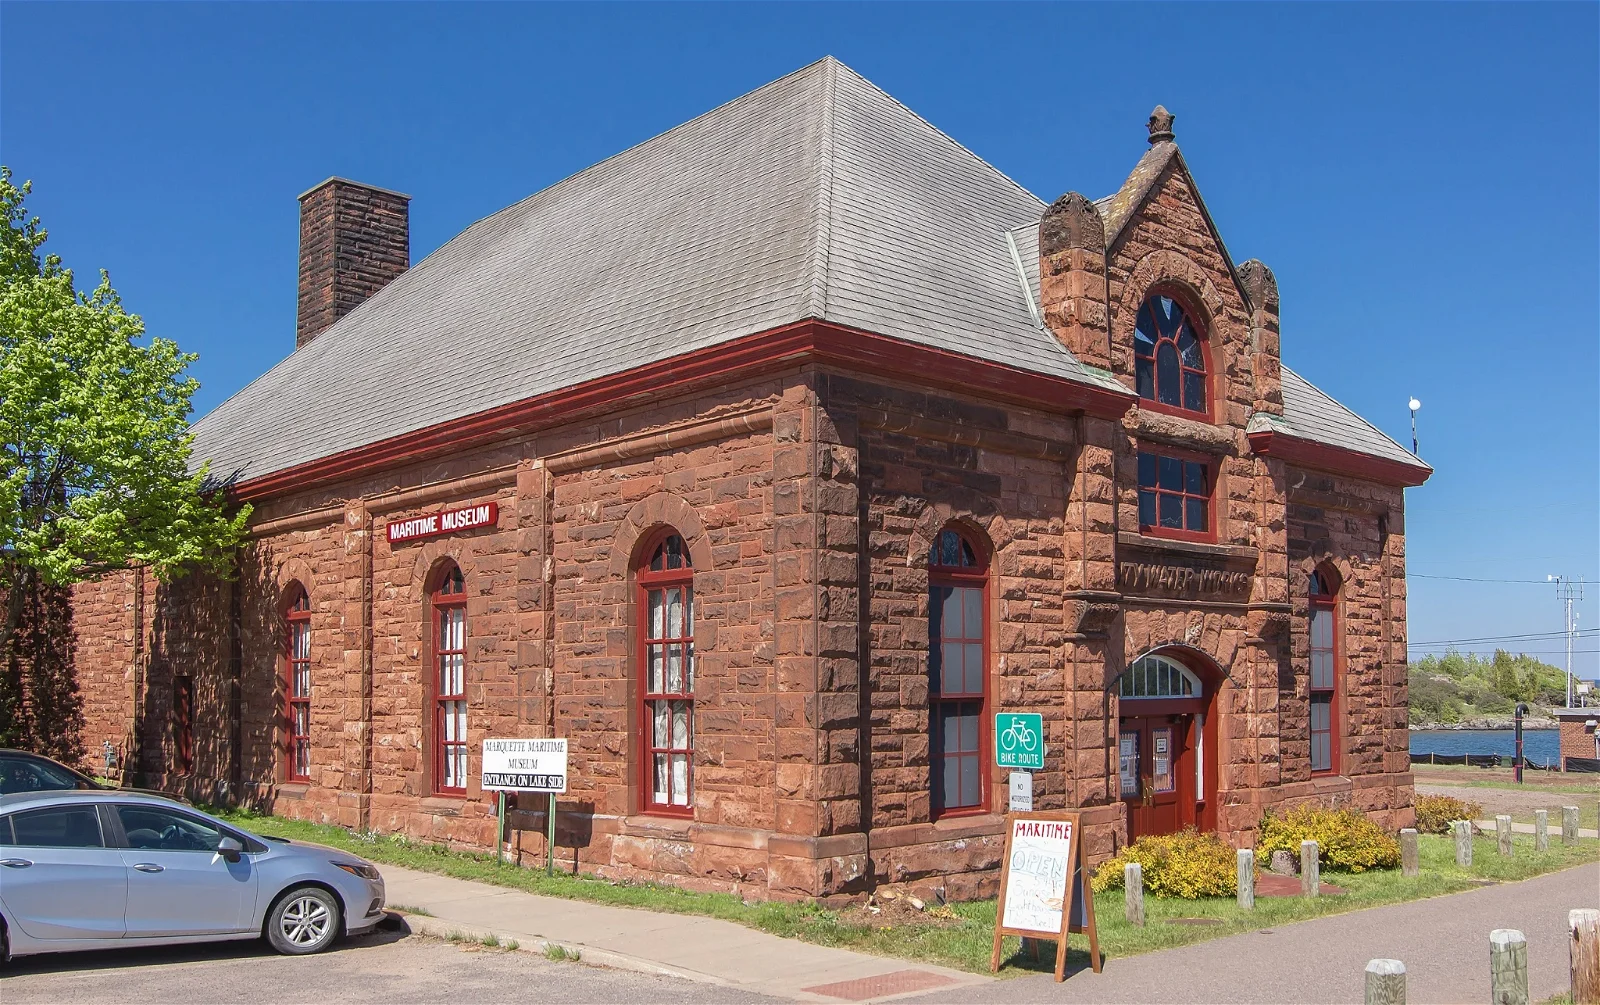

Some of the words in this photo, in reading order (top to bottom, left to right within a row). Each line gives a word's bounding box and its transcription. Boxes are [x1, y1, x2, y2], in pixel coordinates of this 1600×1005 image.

[390, 515, 438, 540] MARITIME
[441, 505, 490, 531] MUSEUM
[1143, 564, 1195, 591] WATER
[1198, 568, 1249, 595] WORKS
[485, 741, 525, 754] MARQUETTE
[527, 741, 565, 753] MARITIME
[507, 758, 538, 770] MUSEUM
[1000, 752, 1016, 763] BIKE
[1018, 753, 1039, 765] ROUTE
[484, 773, 517, 786] ENTRANCE
[517, 774, 528, 787] ON
[529, 775, 547, 788] LAKE
[548, 776, 563, 788] SIDE
[1017, 783, 1024, 791] NO
[1015, 823, 1073, 840] MARITIME
[1012, 850, 1068, 879] OPEN
